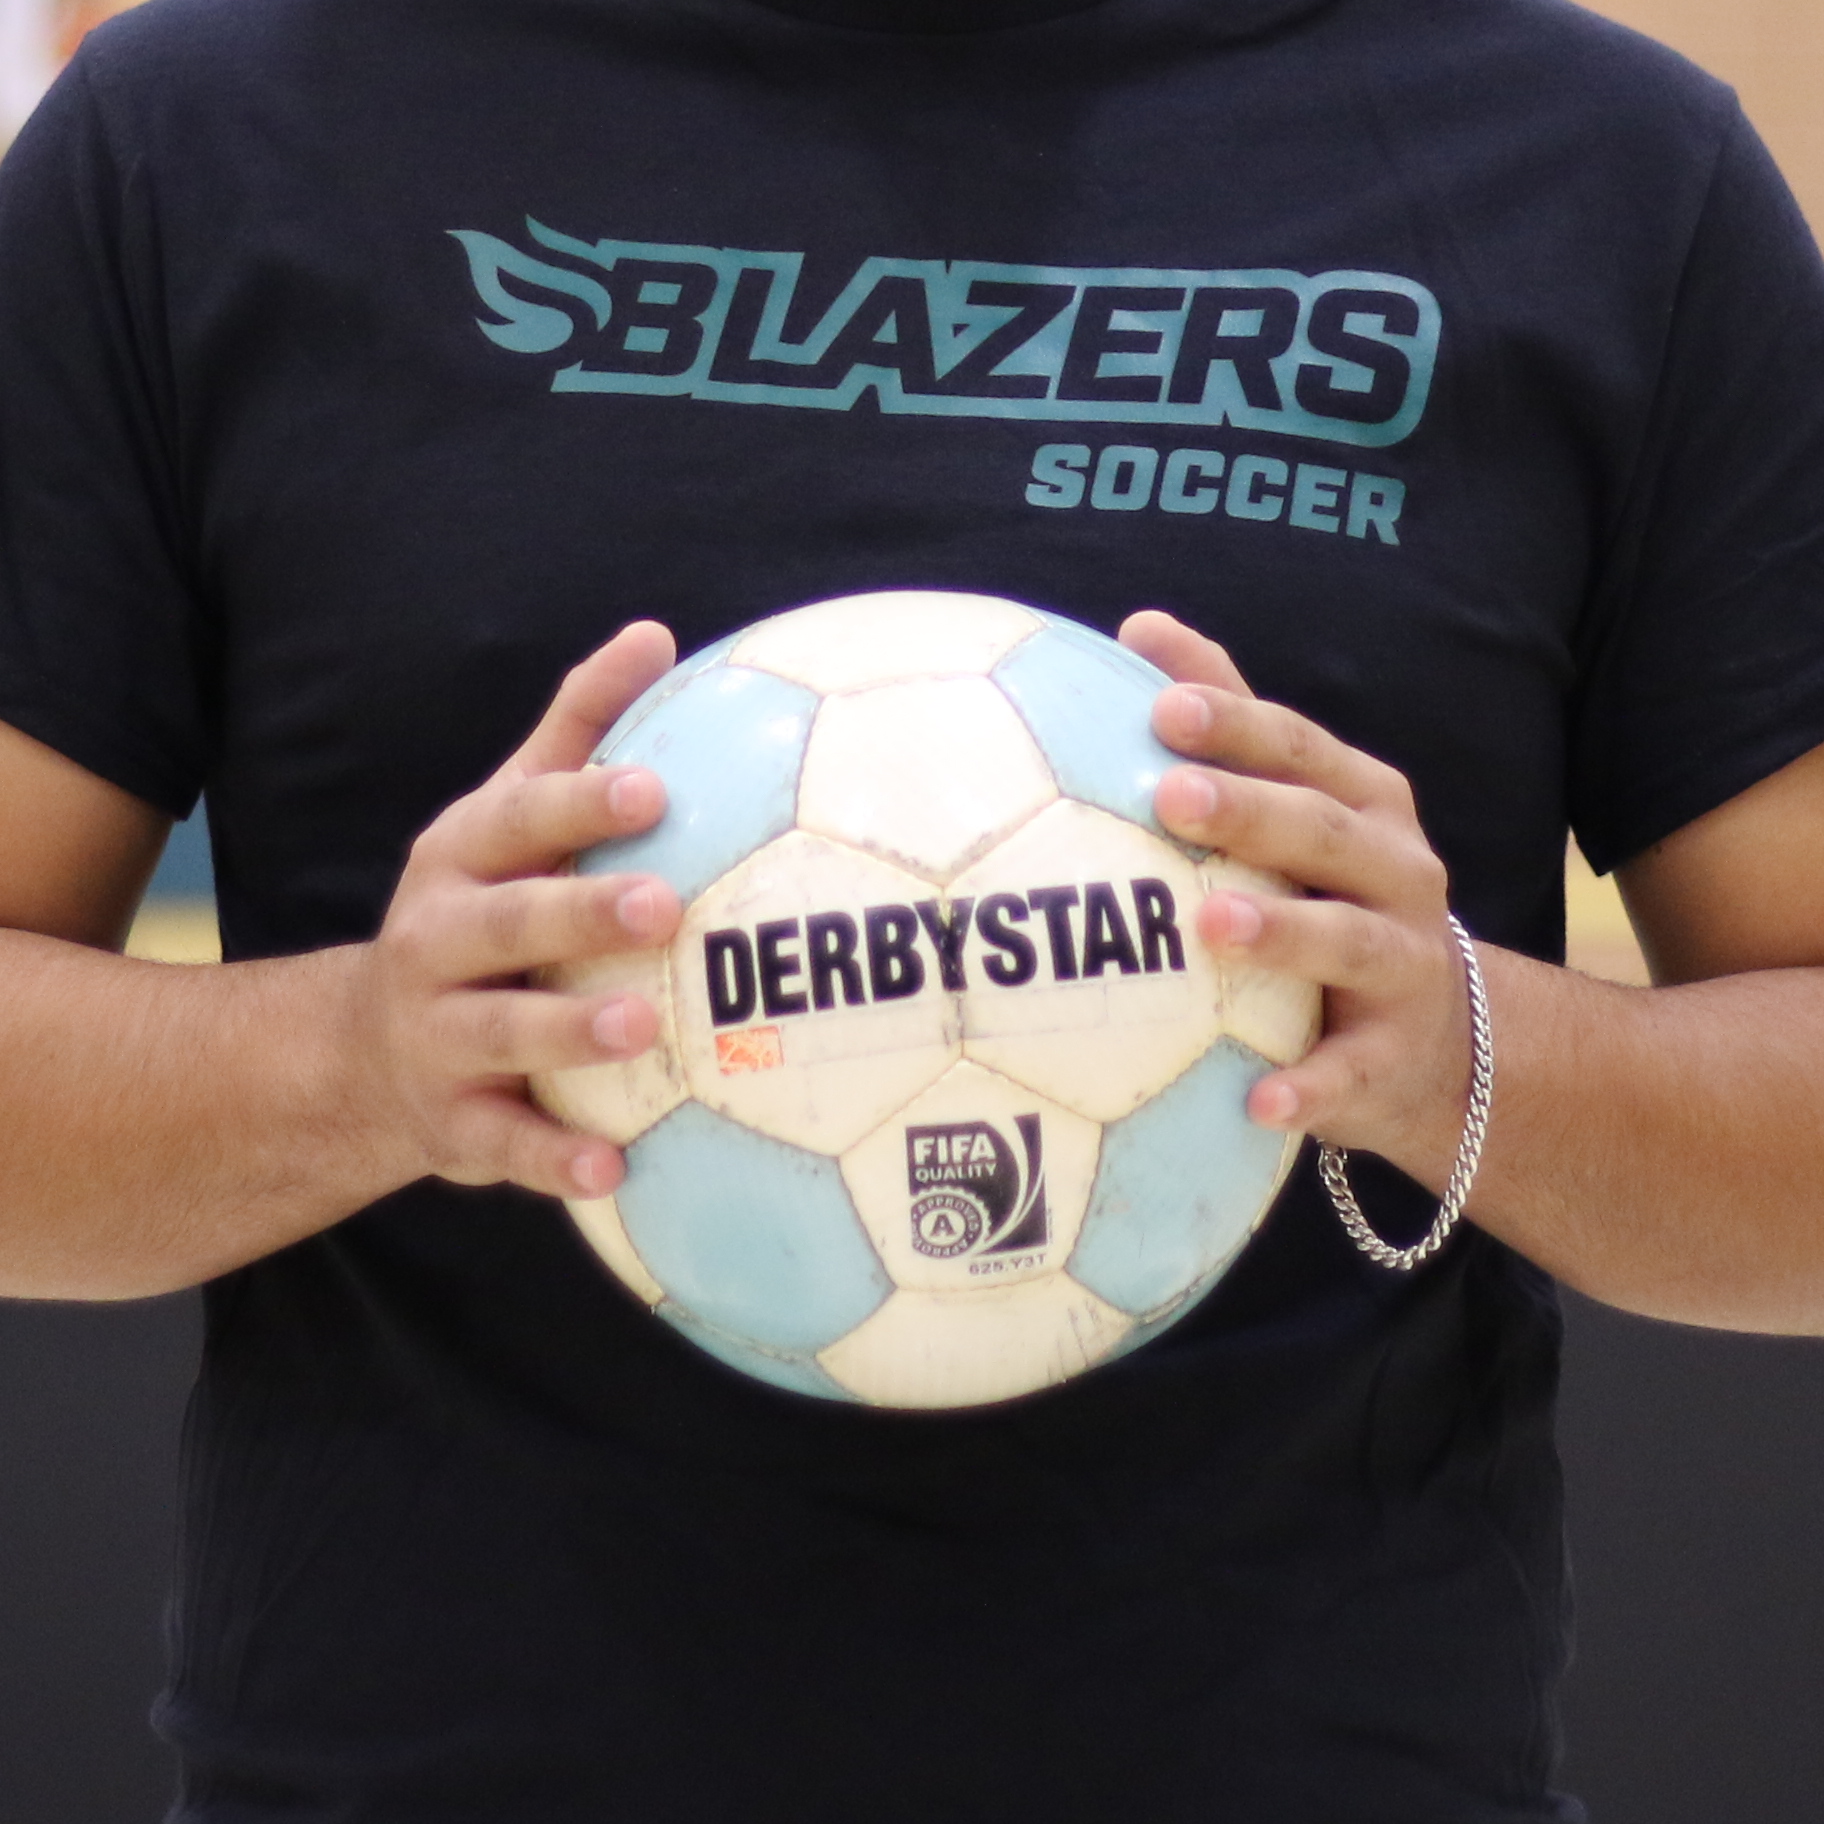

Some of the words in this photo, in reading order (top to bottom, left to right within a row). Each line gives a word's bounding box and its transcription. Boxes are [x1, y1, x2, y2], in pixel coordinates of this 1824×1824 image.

[552, 238, 1442, 446] BLAZERS
[1025, 443, 1406, 545] SOCCER
[703, 877, 1187, 1027] DERBYSTAR
[913, 1133, 997, 1166] FIFA
[915, 1162, 997, 1184] QUALITY
[917, 1196, 980, 1232] APPROVED
[929, 1213, 957, 1237] A
